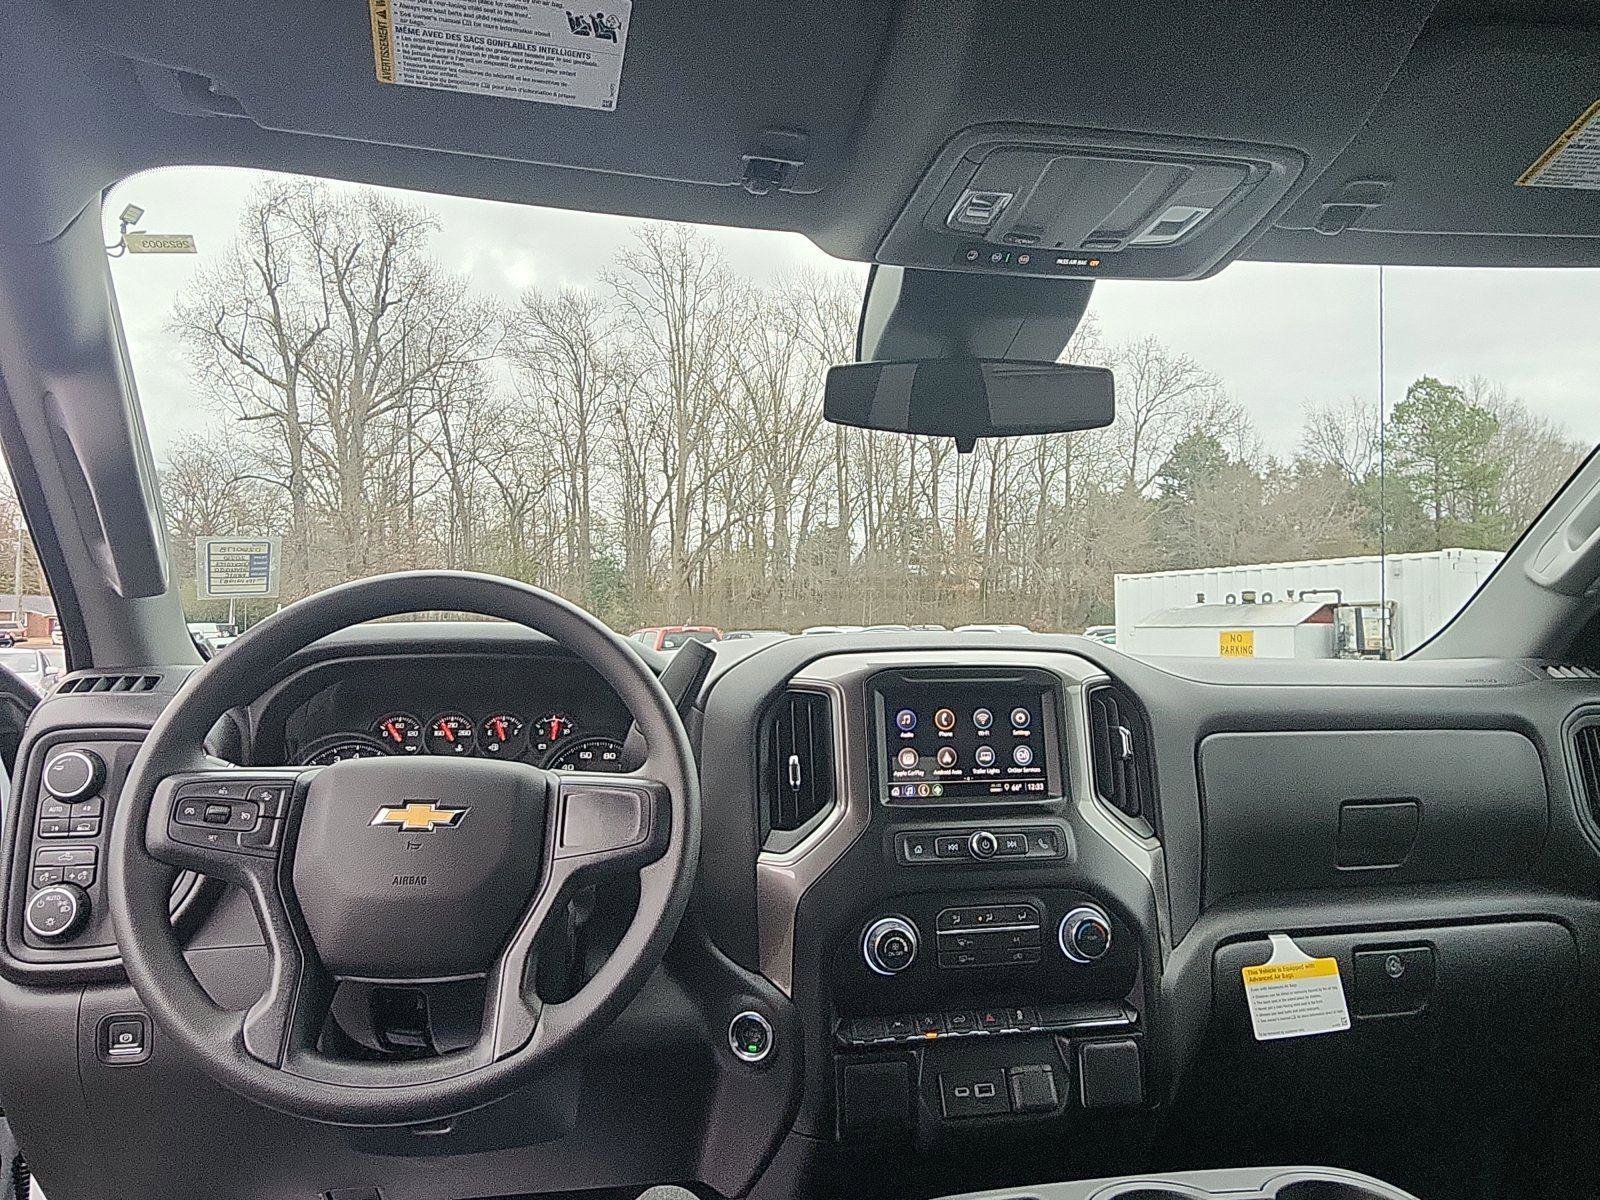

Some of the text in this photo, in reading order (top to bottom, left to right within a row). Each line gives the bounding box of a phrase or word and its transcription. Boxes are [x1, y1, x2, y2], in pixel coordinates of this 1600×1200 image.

[421, 29, 444, 39] AVEC
[444, 32, 462, 41] DES
[462, 35, 484, 45] SACS
[486, 38, 537, 52] GONFLABLES
[537, 45, 591, 59] INTELLIGENTS
[1230, 633, 1243, 643] NO
[1220, 645, 1254, 655] PARKING
[580, 751, 593, 759] 60
[603, 751, 617, 760] 80
[561, 763, 575, 771] 40
[893, 770, 908, 778] Apple
[391, 875, 428, 886] AIRBAG
